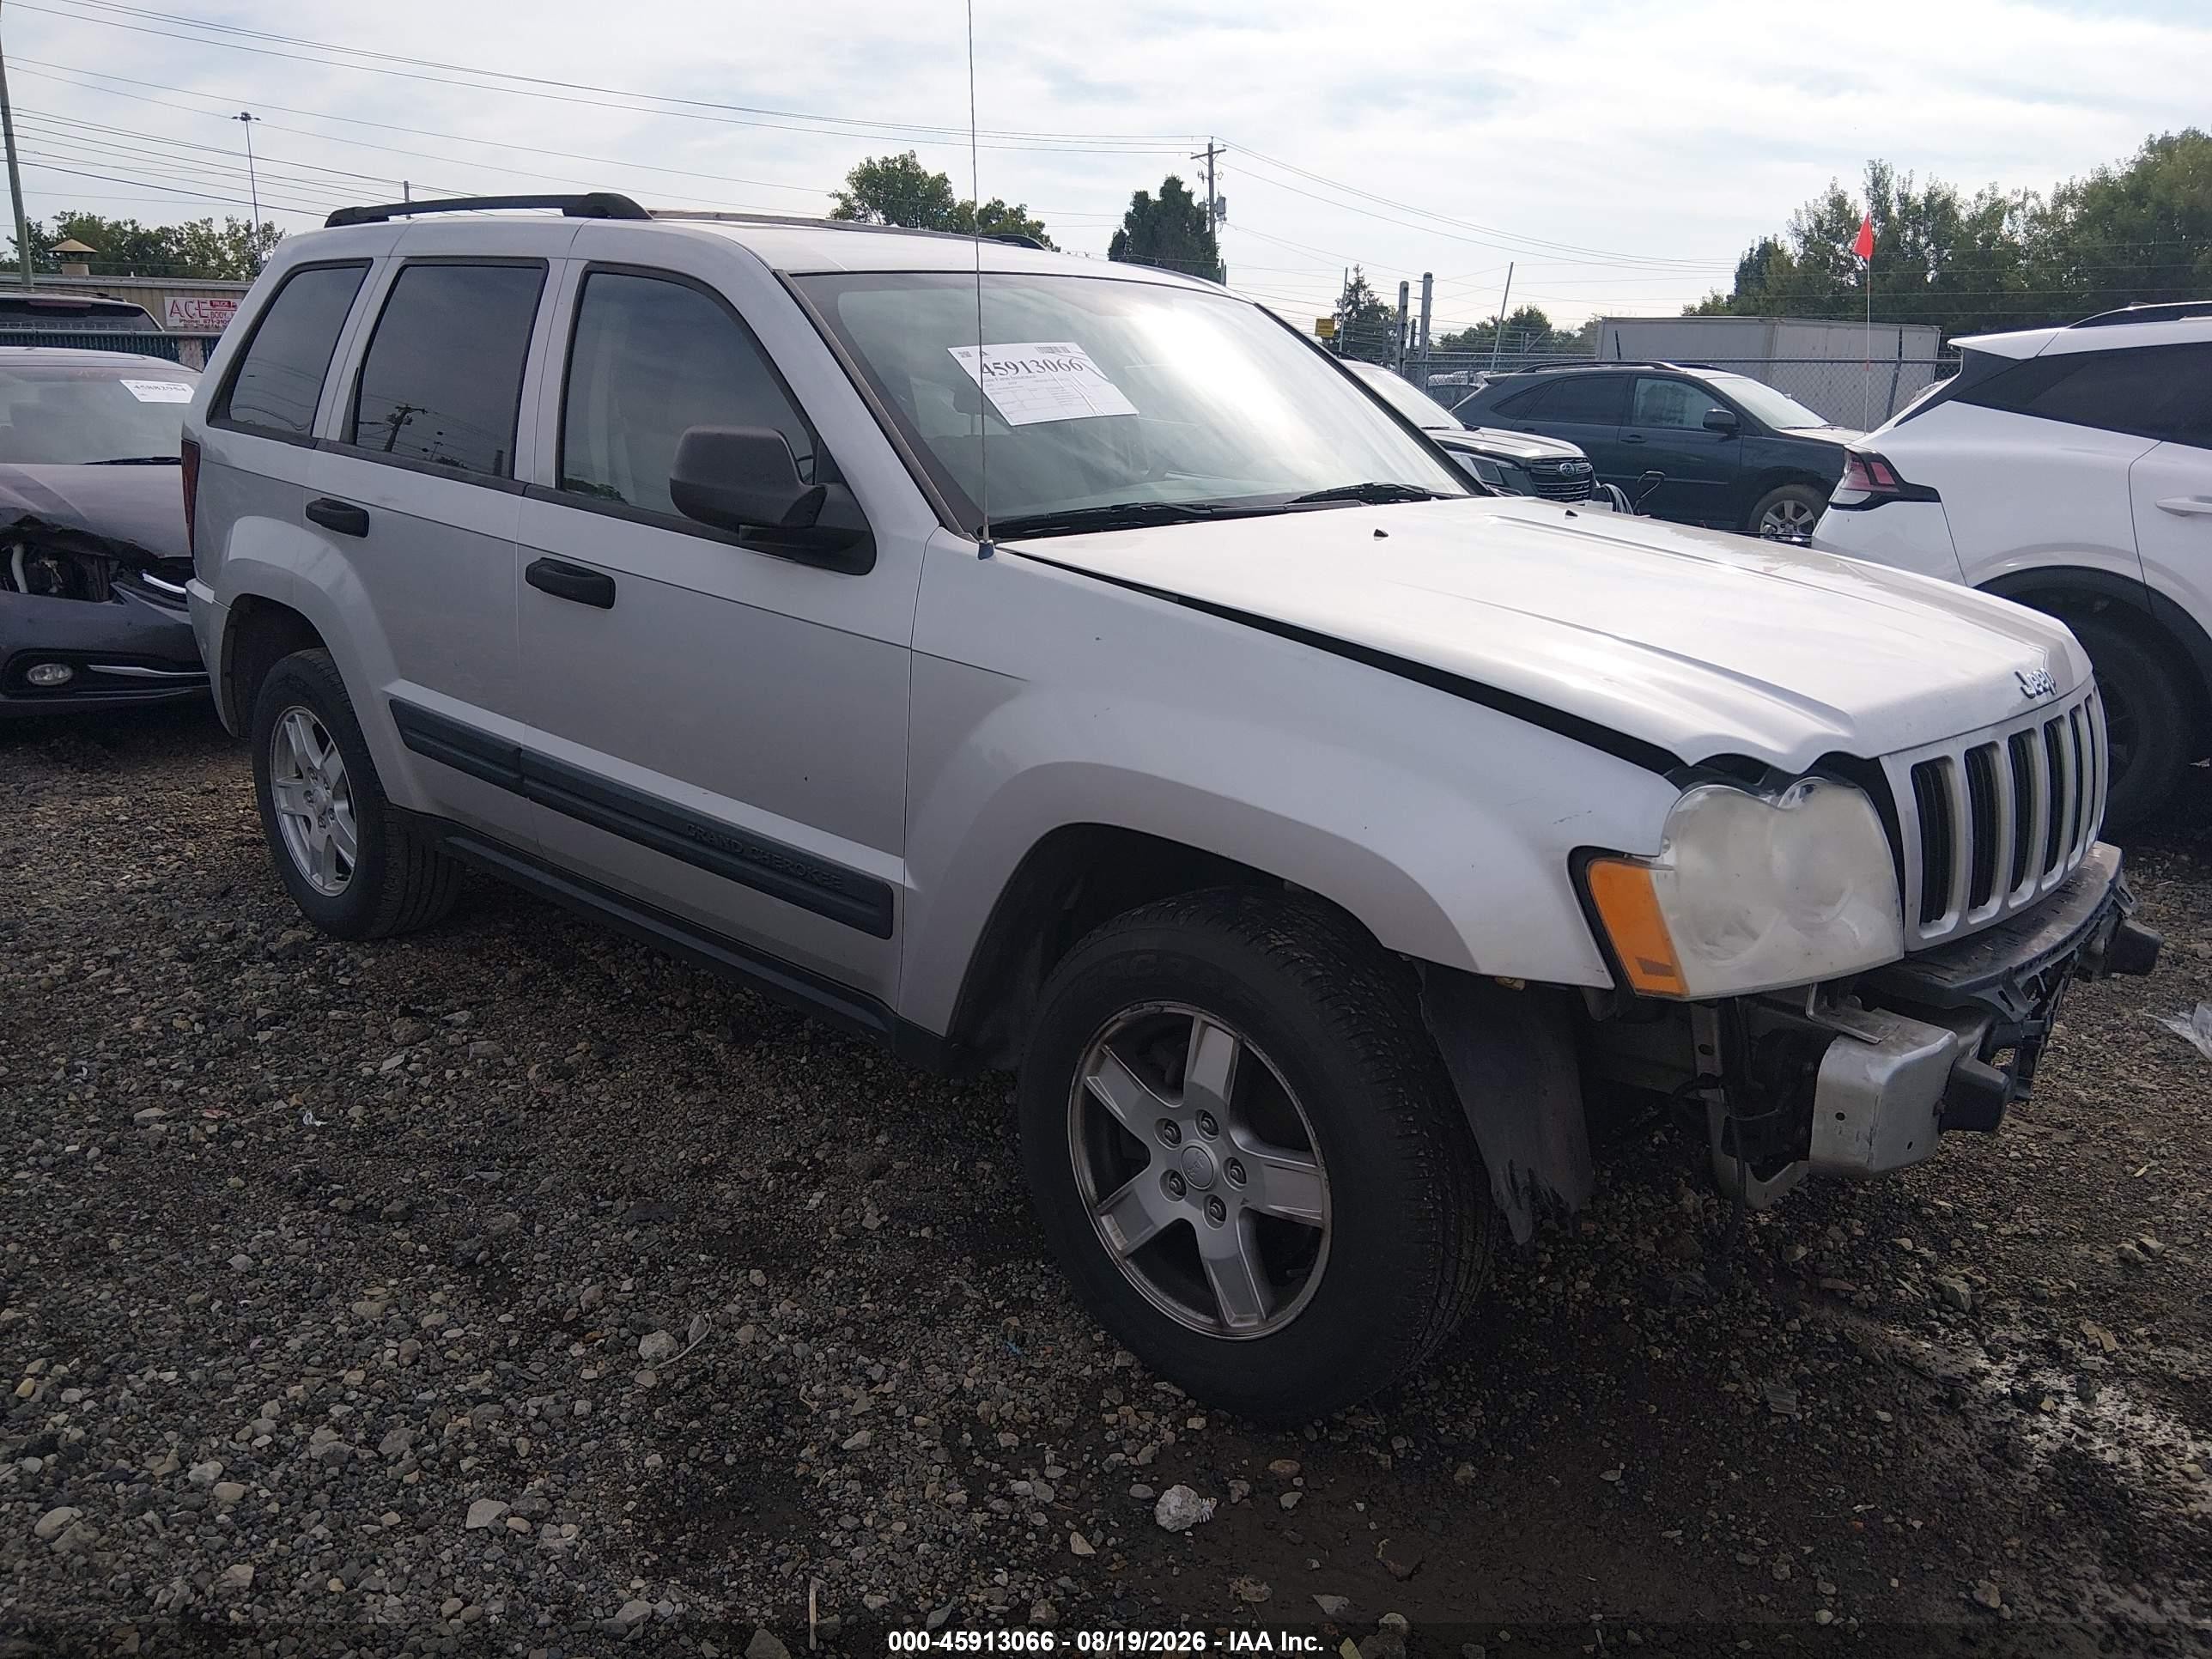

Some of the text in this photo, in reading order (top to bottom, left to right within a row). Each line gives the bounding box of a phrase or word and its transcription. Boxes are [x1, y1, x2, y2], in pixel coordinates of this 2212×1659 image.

[169, 299, 209, 319] ACE
[981, 358, 1084, 377] 45913066
[2014, 667, 2057, 700] Jeep
[686, 823, 844, 888] GRAND CHEROKEE
